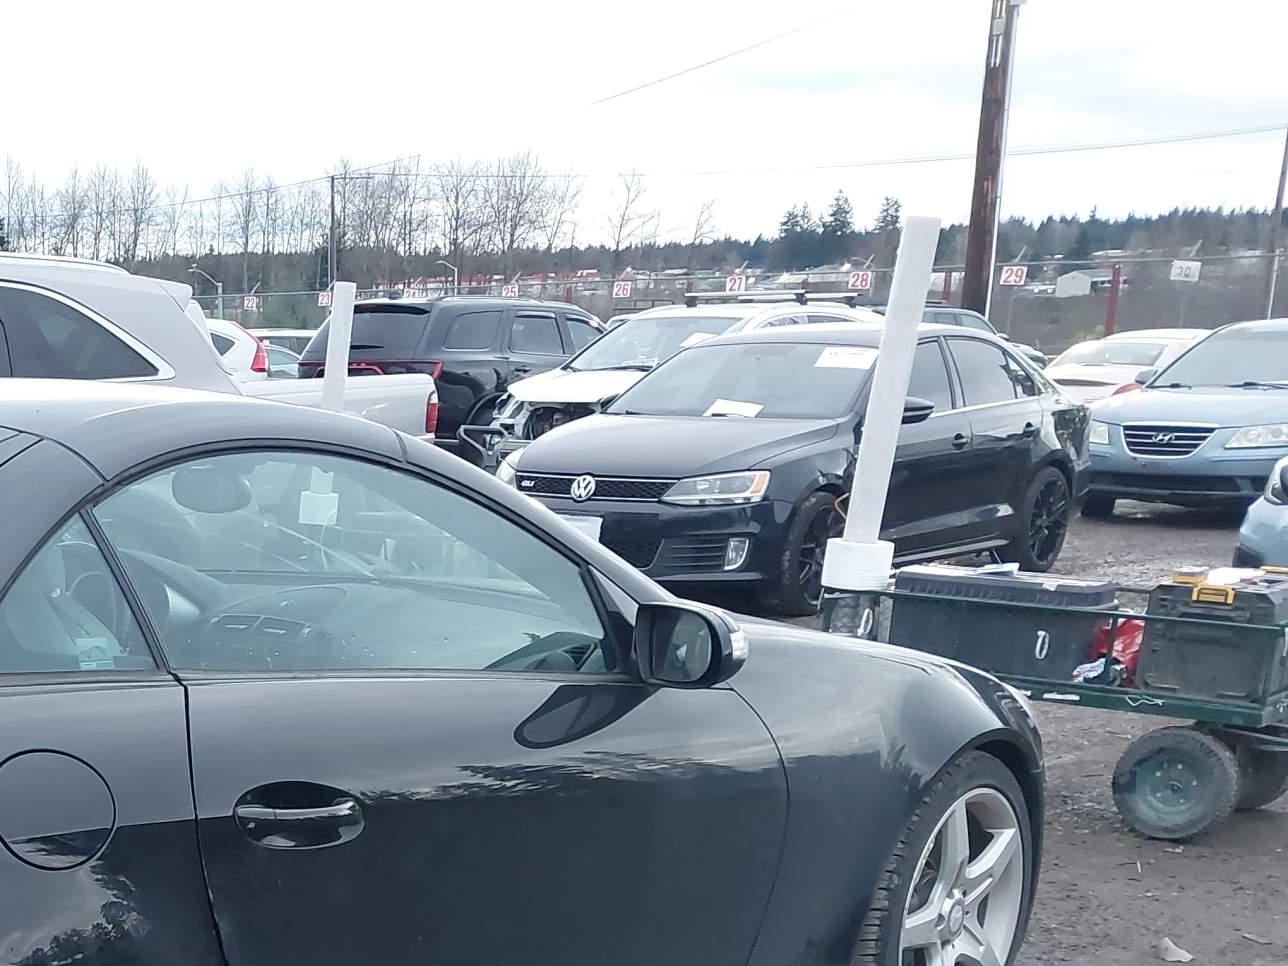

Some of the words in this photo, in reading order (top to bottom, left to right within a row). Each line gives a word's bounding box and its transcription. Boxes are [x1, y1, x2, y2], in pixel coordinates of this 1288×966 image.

[850, 272, 869, 288] 28
[1002, 268, 1024, 284] 29
[615, 283, 629, 297] 26
[728, 277, 743, 291] 27
[503, 286, 517, 297] 25
[245, 298, 255, 309] 22
[320, 294, 330, 305] 23
